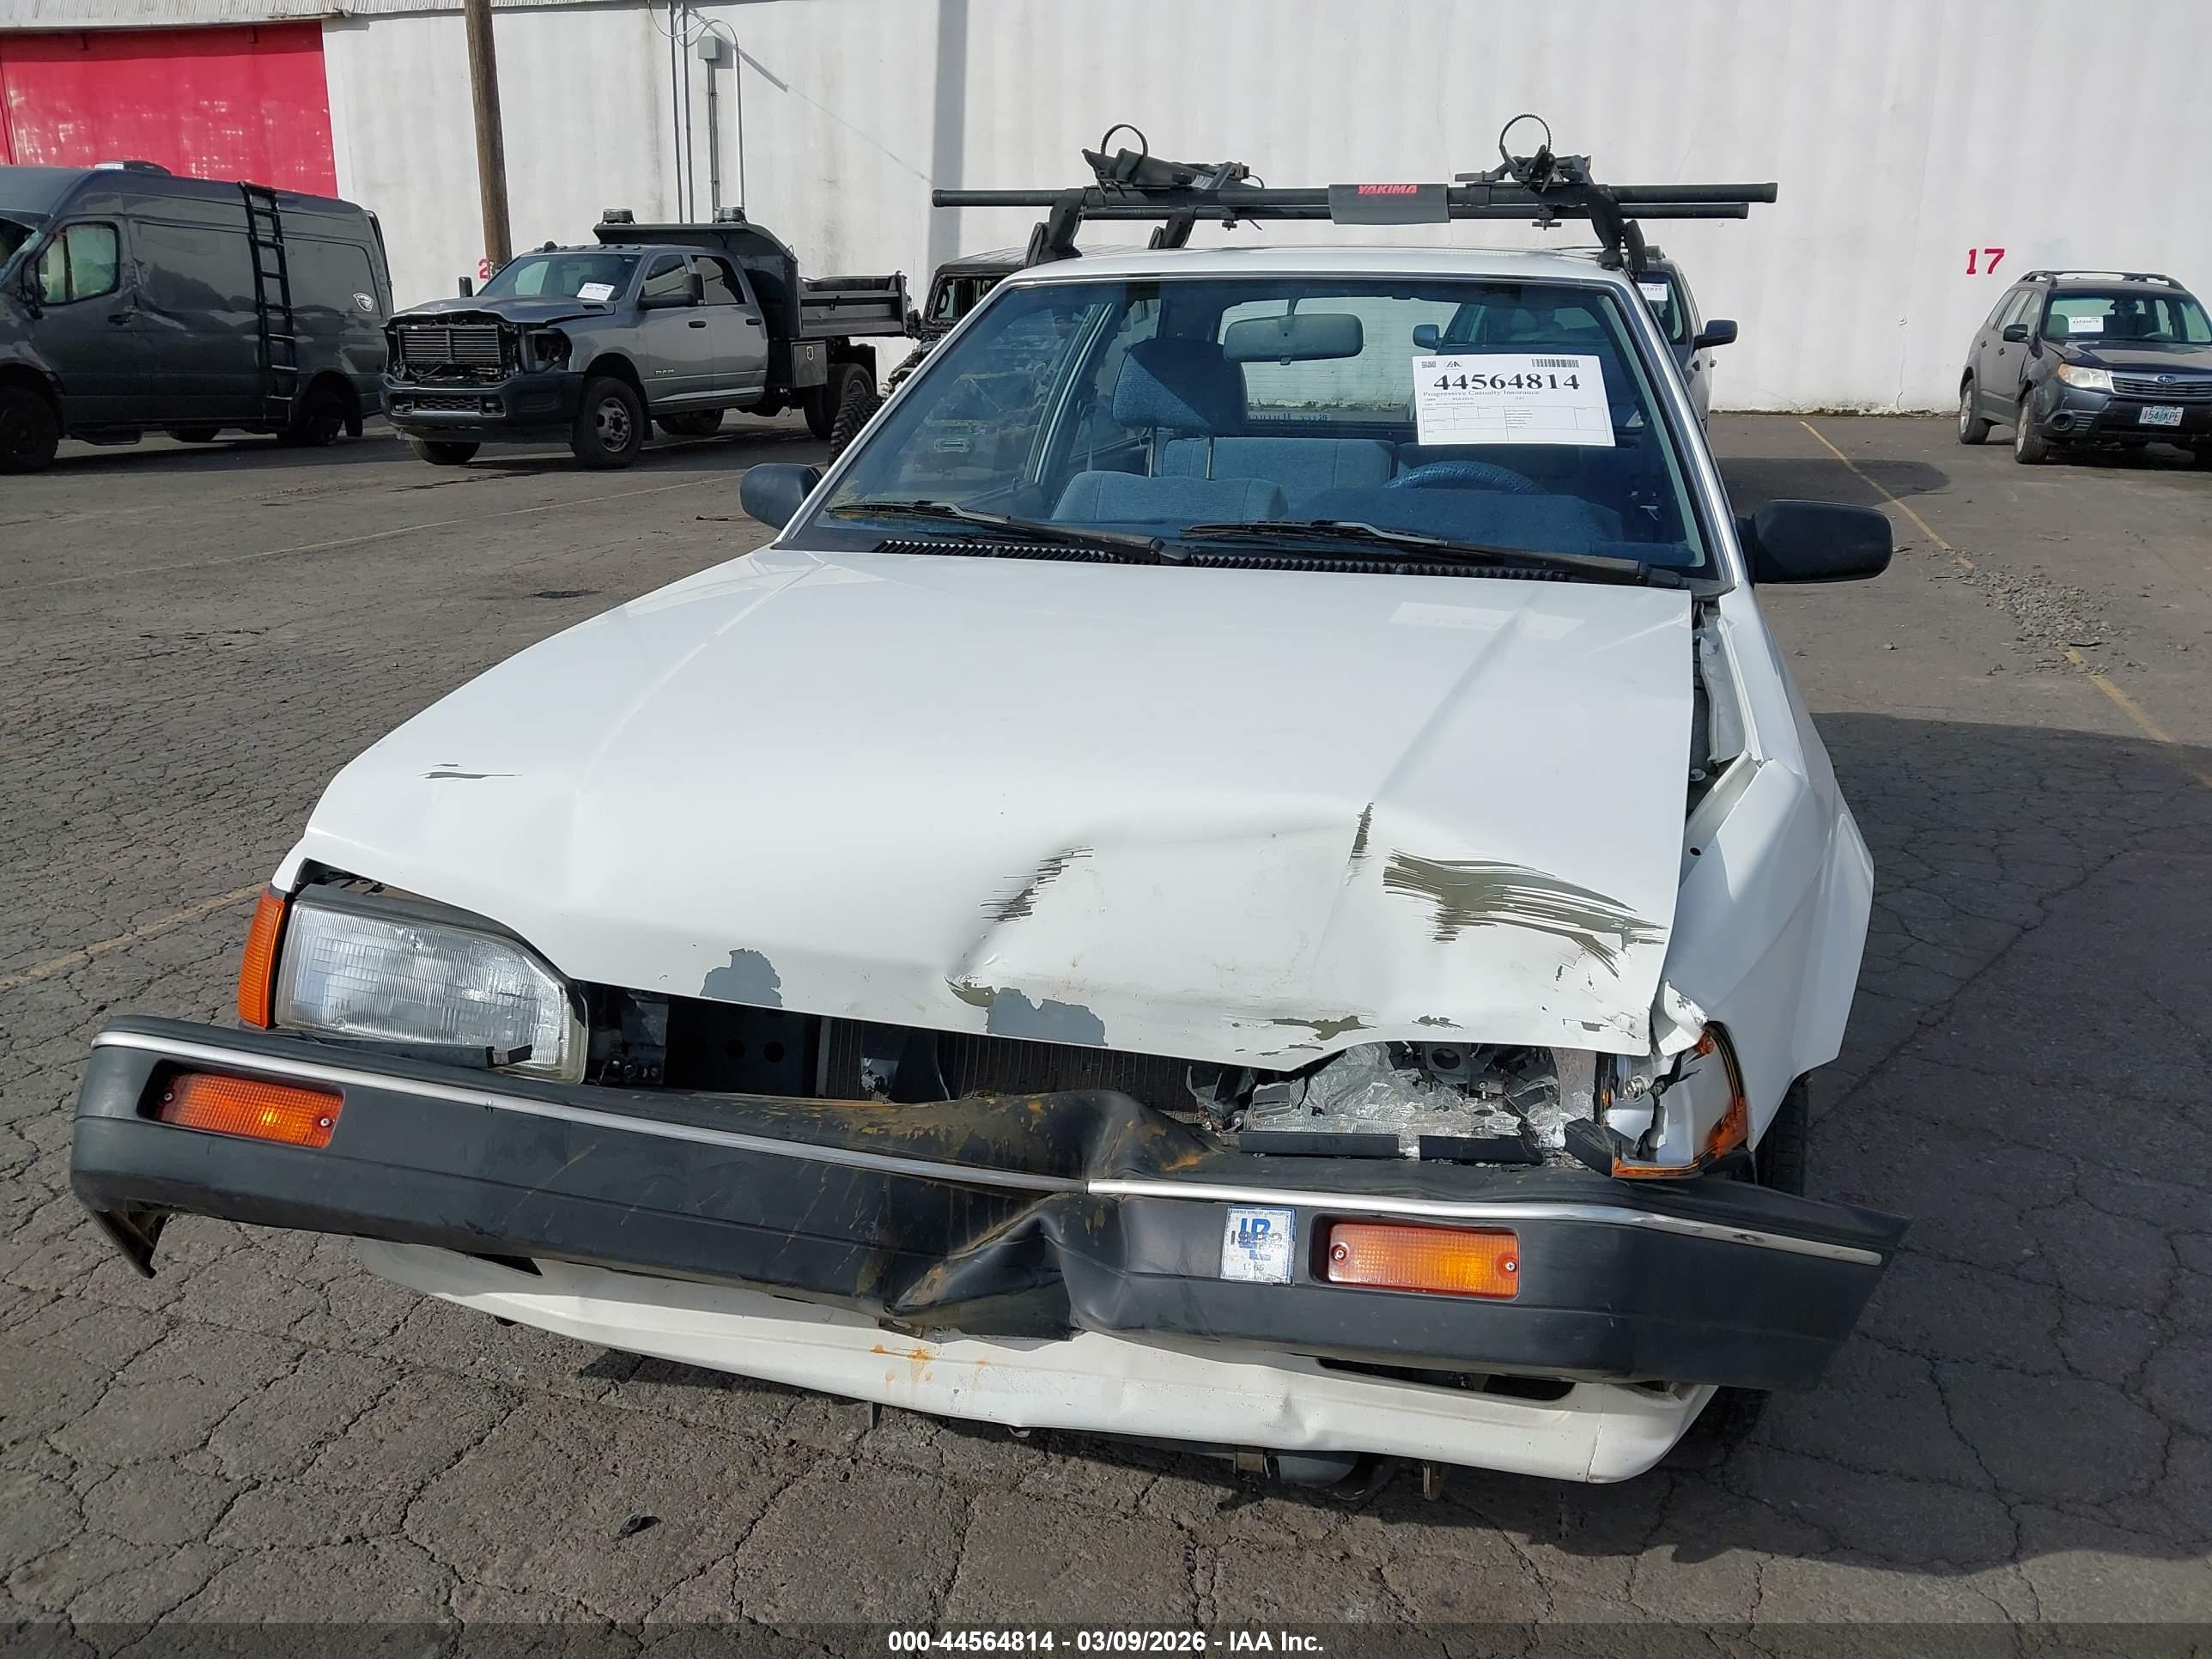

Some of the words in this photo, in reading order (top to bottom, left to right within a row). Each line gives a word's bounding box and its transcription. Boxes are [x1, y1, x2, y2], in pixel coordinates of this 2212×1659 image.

[1358, 185, 1418, 194] YAKIMA
[1966, 248, 2005, 275] 17
[1433, 374, 1580, 390] 44564814
